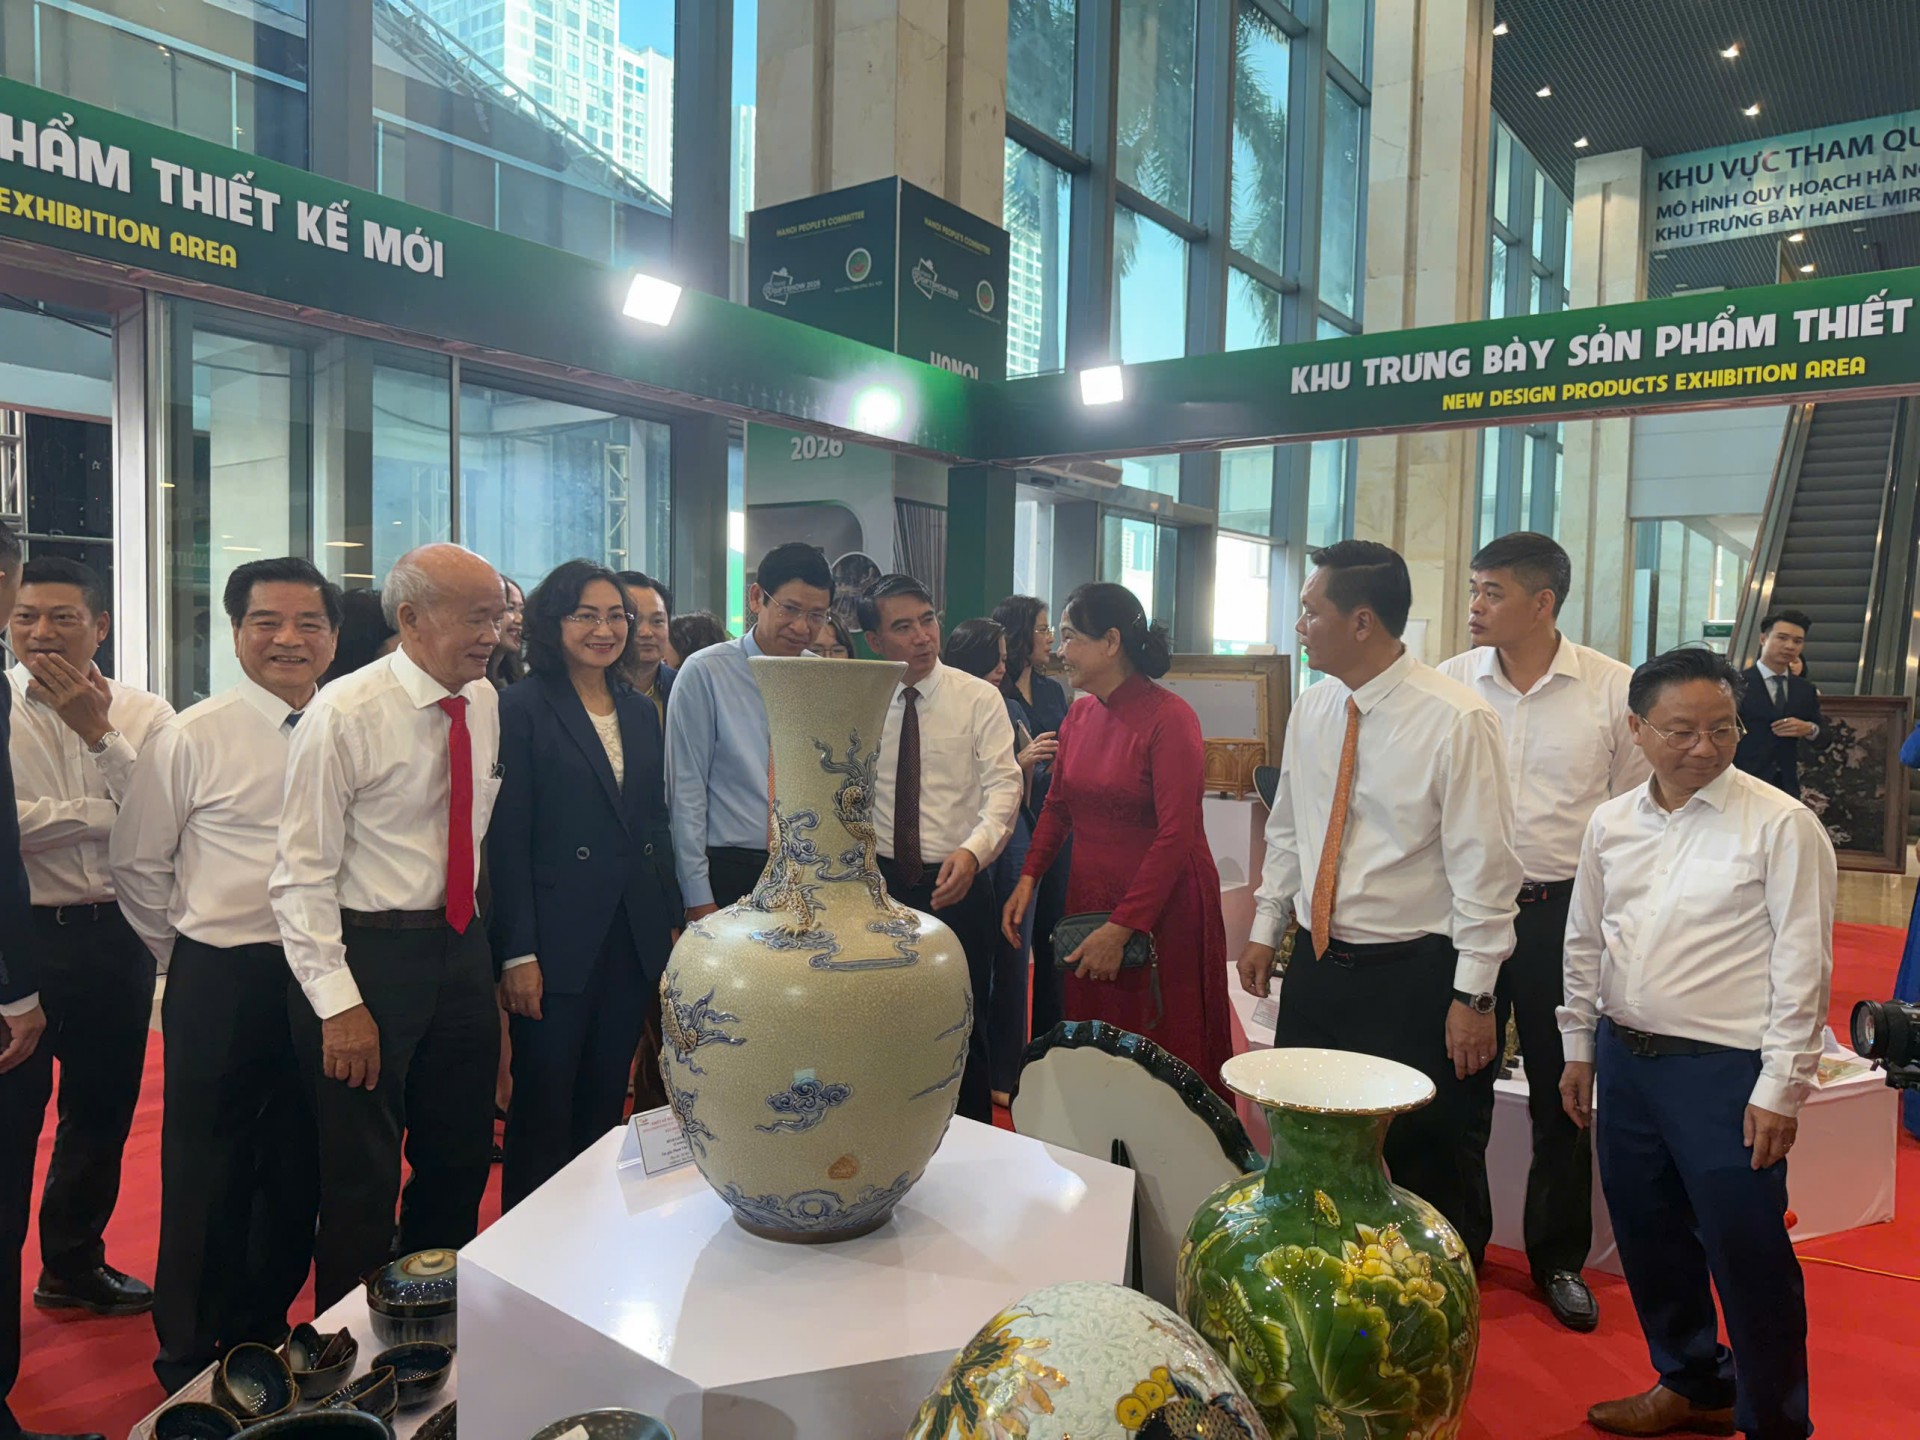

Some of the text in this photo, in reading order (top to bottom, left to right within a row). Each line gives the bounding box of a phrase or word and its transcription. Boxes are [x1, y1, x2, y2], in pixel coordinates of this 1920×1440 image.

[1657, 163, 1714, 191] KHU
[1721, 151, 1780, 181] VỰC
[1786, 134, 1873, 168] THAM
[0, 112, 444, 278] HẨM THIẾT KẾ MỚI
[1656, 200, 1687, 220] MÔ
[1692, 193, 1737, 214] HÌNH
[1743, 186, 1784, 206] QUY
[1790, 172, 1861, 196] HOẠCH
[1867, 164, 1897, 185] HÀ
[1656, 224, 1693, 242] KHU
[1700, 211, 1763, 234] TRƯNG
[1768, 205, 1804, 225] BÀY
[1809, 195, 1877, 217] HANEL
[0, 187, 237, 268] EXHIBITION AREA
[1290, 288, 1913, 394] KHU TRƯNG BÀY SẢN PHẨM THIẾT
[1442, 356, 1866, 411] NEW DESIGN PRODUCTS EXHIBITION AREA
[790, 435, 845, 461] 2026
